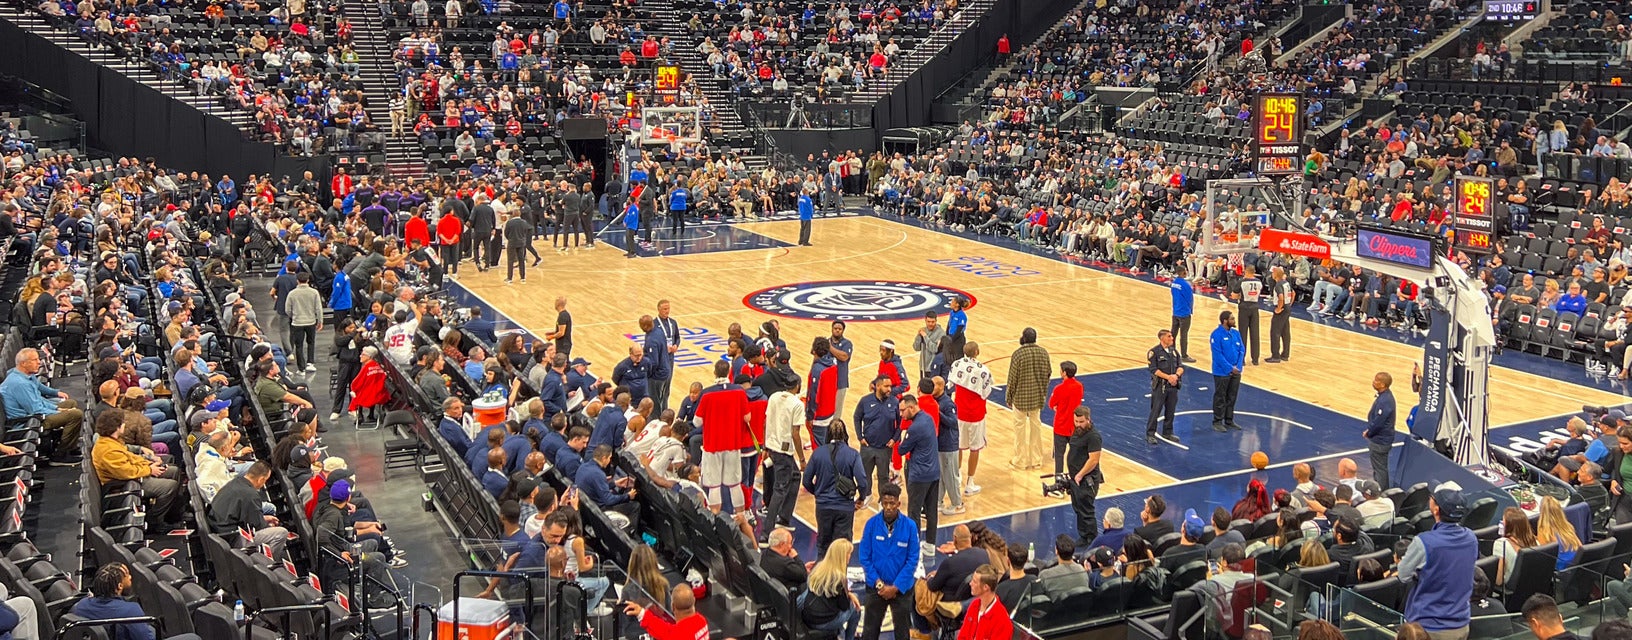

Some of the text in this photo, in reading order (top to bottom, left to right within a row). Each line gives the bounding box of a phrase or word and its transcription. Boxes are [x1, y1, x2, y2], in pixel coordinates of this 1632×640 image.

[1488, 3, 1523, 13] 2ND 10:46
[658, 66, 677, 75] 10:46
[657, 74, 676, 88] 24
[1266, 98, 1296, 113] 10:46
[1264, 114, 1293, 141] 24
[1464, 181, 1489, 198] 10:46
[1465, 196, 1485, 213] 24
[1466, 218, 1491, 228] TISSOT
[1370, 234, 1417, 258] Clippers
[756, 286, 798, 314] ANGELES
[1429, 357, 1441, 412] PECHANGA
[1424, 386, 1433, 412] CASINO
